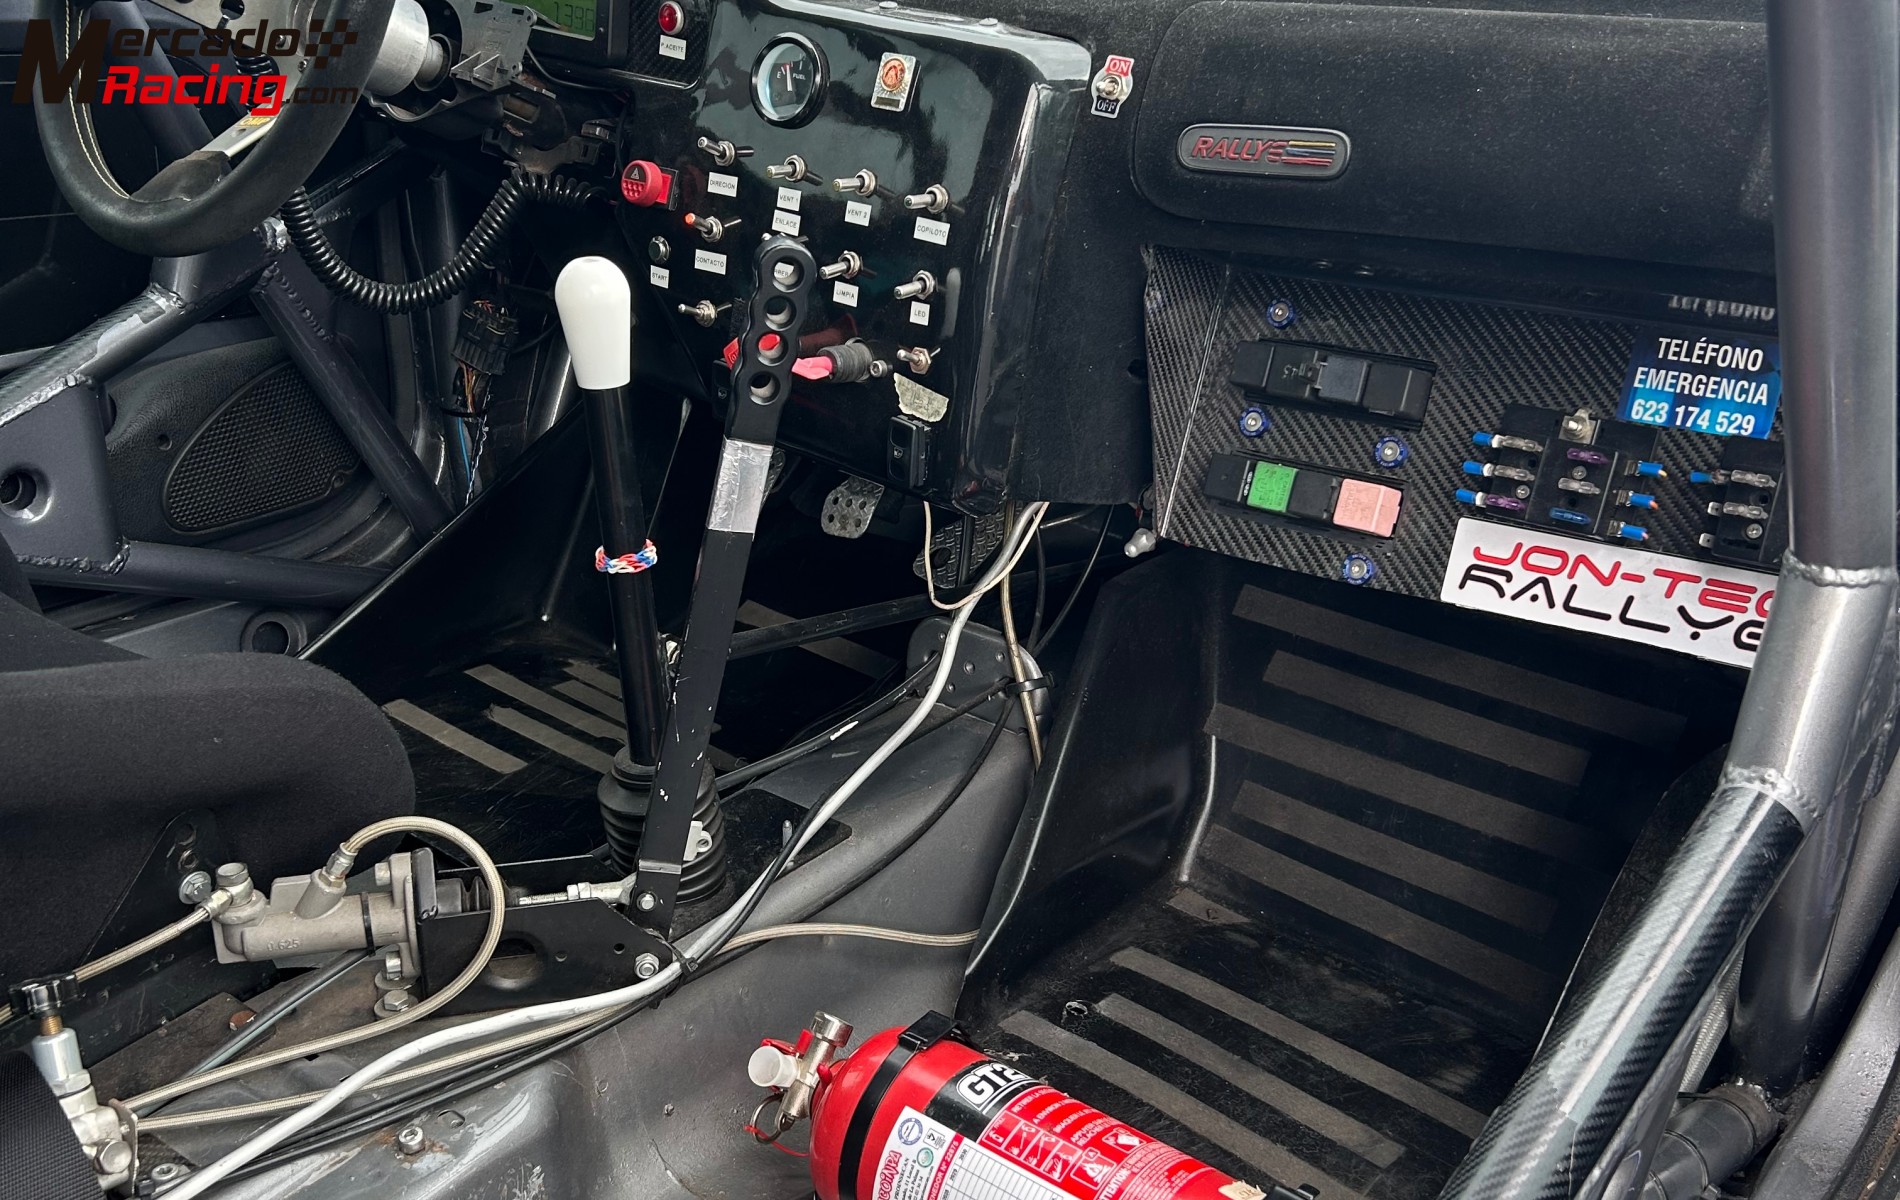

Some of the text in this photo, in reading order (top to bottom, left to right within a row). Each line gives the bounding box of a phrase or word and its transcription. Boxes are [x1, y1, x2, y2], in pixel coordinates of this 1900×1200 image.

[1109, 60, 1131, 74] ON
[792, 72, 806, 81] FUEL
[1097, 99, 1117, 112] OFF
[1191, 136, 1288, 165] RALLYE
[779, 194, 794, 203] VENT
[847, 209, 863, 218] VENT
[774, 217, 798, 229] ENLACE
[916, 224, 947, 238] COPILOTO
[695, 255, 725, 268] CONTACTO
[651, 271, 668, 281] START
[836, 290, 855, 299] LIMPIA
[914, 309, 926, 318] LED
[1658, 338, 1764, 372] TELÉFONO
[1633, 367, 1769, 406] EMERGENCIA
[1631, 399, 1756, 436] 623 174 529
